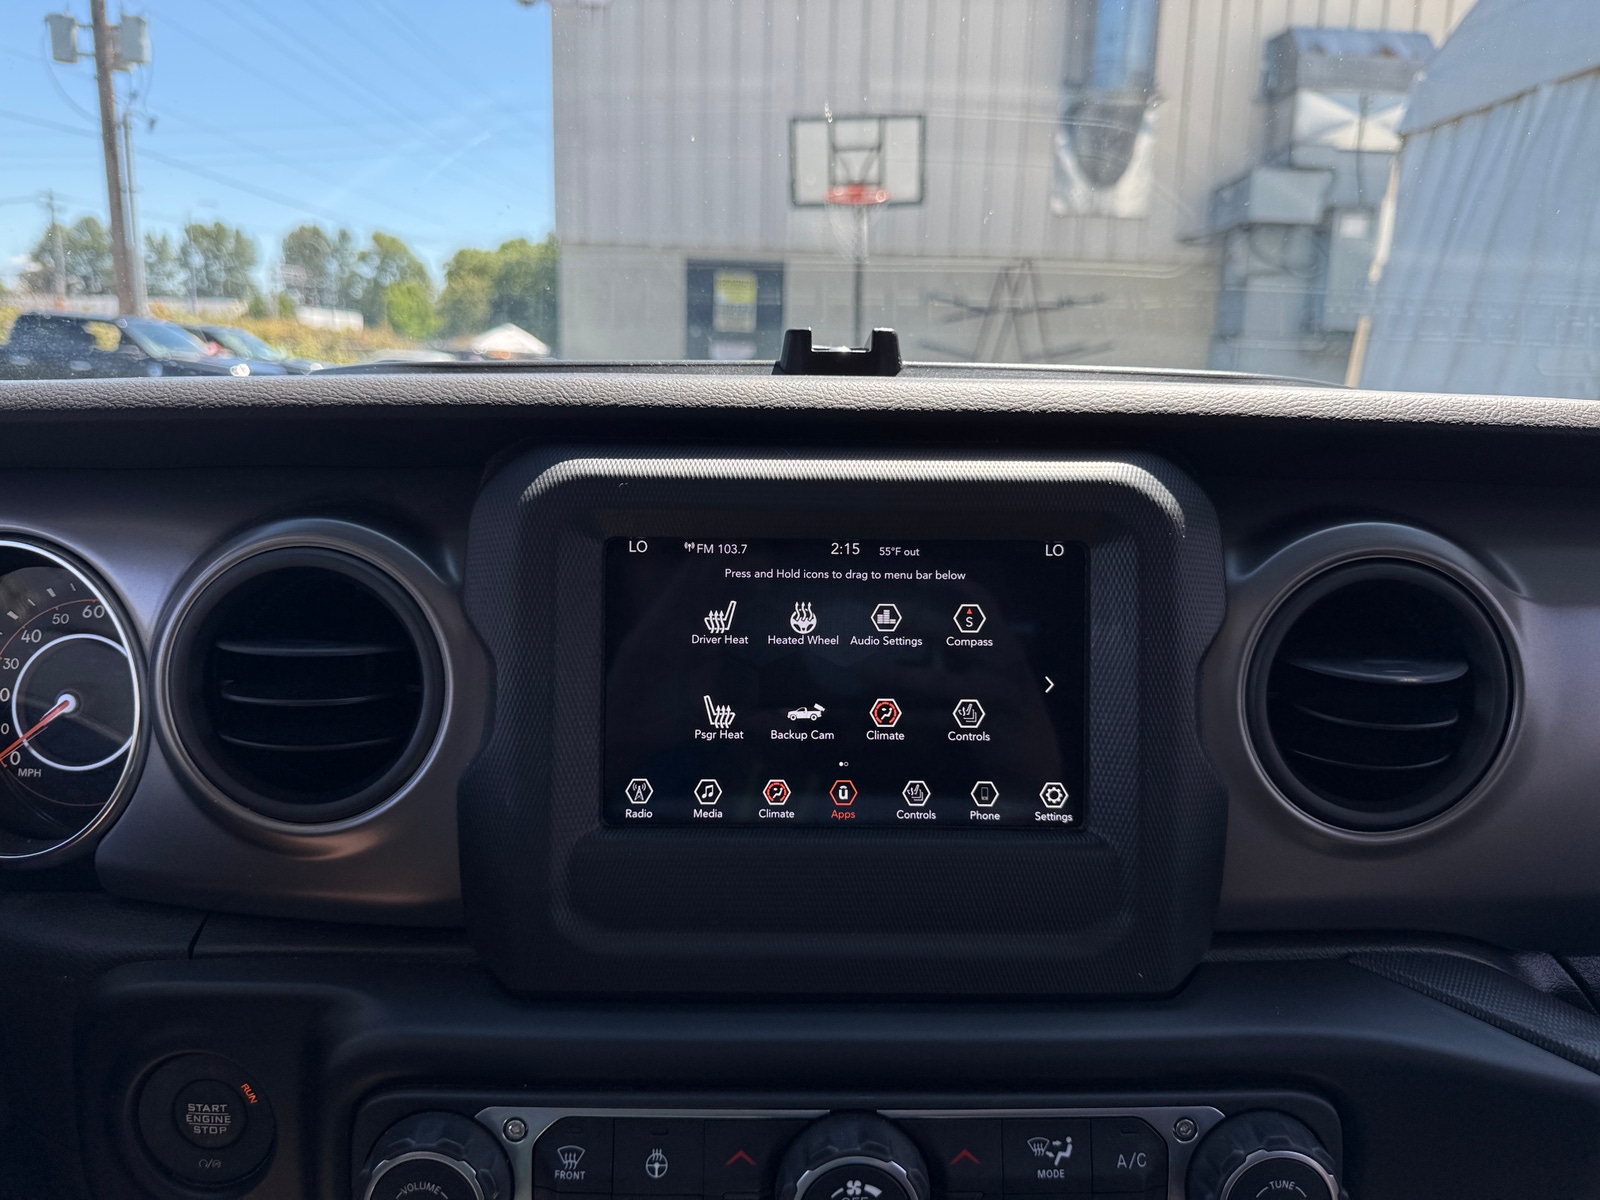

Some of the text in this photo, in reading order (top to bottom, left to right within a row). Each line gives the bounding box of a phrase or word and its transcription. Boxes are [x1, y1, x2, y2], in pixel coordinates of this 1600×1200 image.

[629, 540, 648, 553] LO
[697, 543, 747, 554] FM 103.7
[831, 542, 860, 555] 2:15
[904, 548, 920, 556] out
[1045, 544, 1064, 557] LO
[725, 568, 966, 581] Press and Hold icons to drag to menu bar below
[82, 604, 106, 619] 60
[52, 613, 69, 625] 50
[966, 616, 973, 627] S
[21, 629, 42, 644] 40
[692, 634, 749, 644] Driver Heat
[768, 635, 839, 645] Heated Wheel
[850, 635, 923, 647] Audio Settings
[946, 636, 993, 648] Compass
[3, 658, 19, 670] 30
[695, 729, 744, 741] Psgr Heat
[771, 729, 834, 741] Backup Cam
[866, 730, 905, 740] Climate
[948, 731, 990, 741] Controls
[10, 751, 20, 765] 0
[18, 768, 41, 777] MPH
[625, 808, 653, 818] Radio
[693, 808, 723, 818] Media
[758, 809, 795, 818] Climate
[831, 809, 855, 820] Apps
[896, 809, 936, 819] Controls
[970, 810, 1000, 820] Phone
[1035, 811, 1073, 823] Settings
[240, 1082, 258, 1104] RUN
[187, 1103, 228, 1112] START
[185, 1114, 232, 1124] ENGINE
[193, 1125, 228, 1135] STOP
[1117, 1152, 1146, 1169] A/C
[554, 1170, 586, 1180] FRONT
[1037, 1169, 1064, 1178] MODE
[400, 1181, 442, 1196] VOLUME
[1269, 1180, 1296, 1191] TUNE
